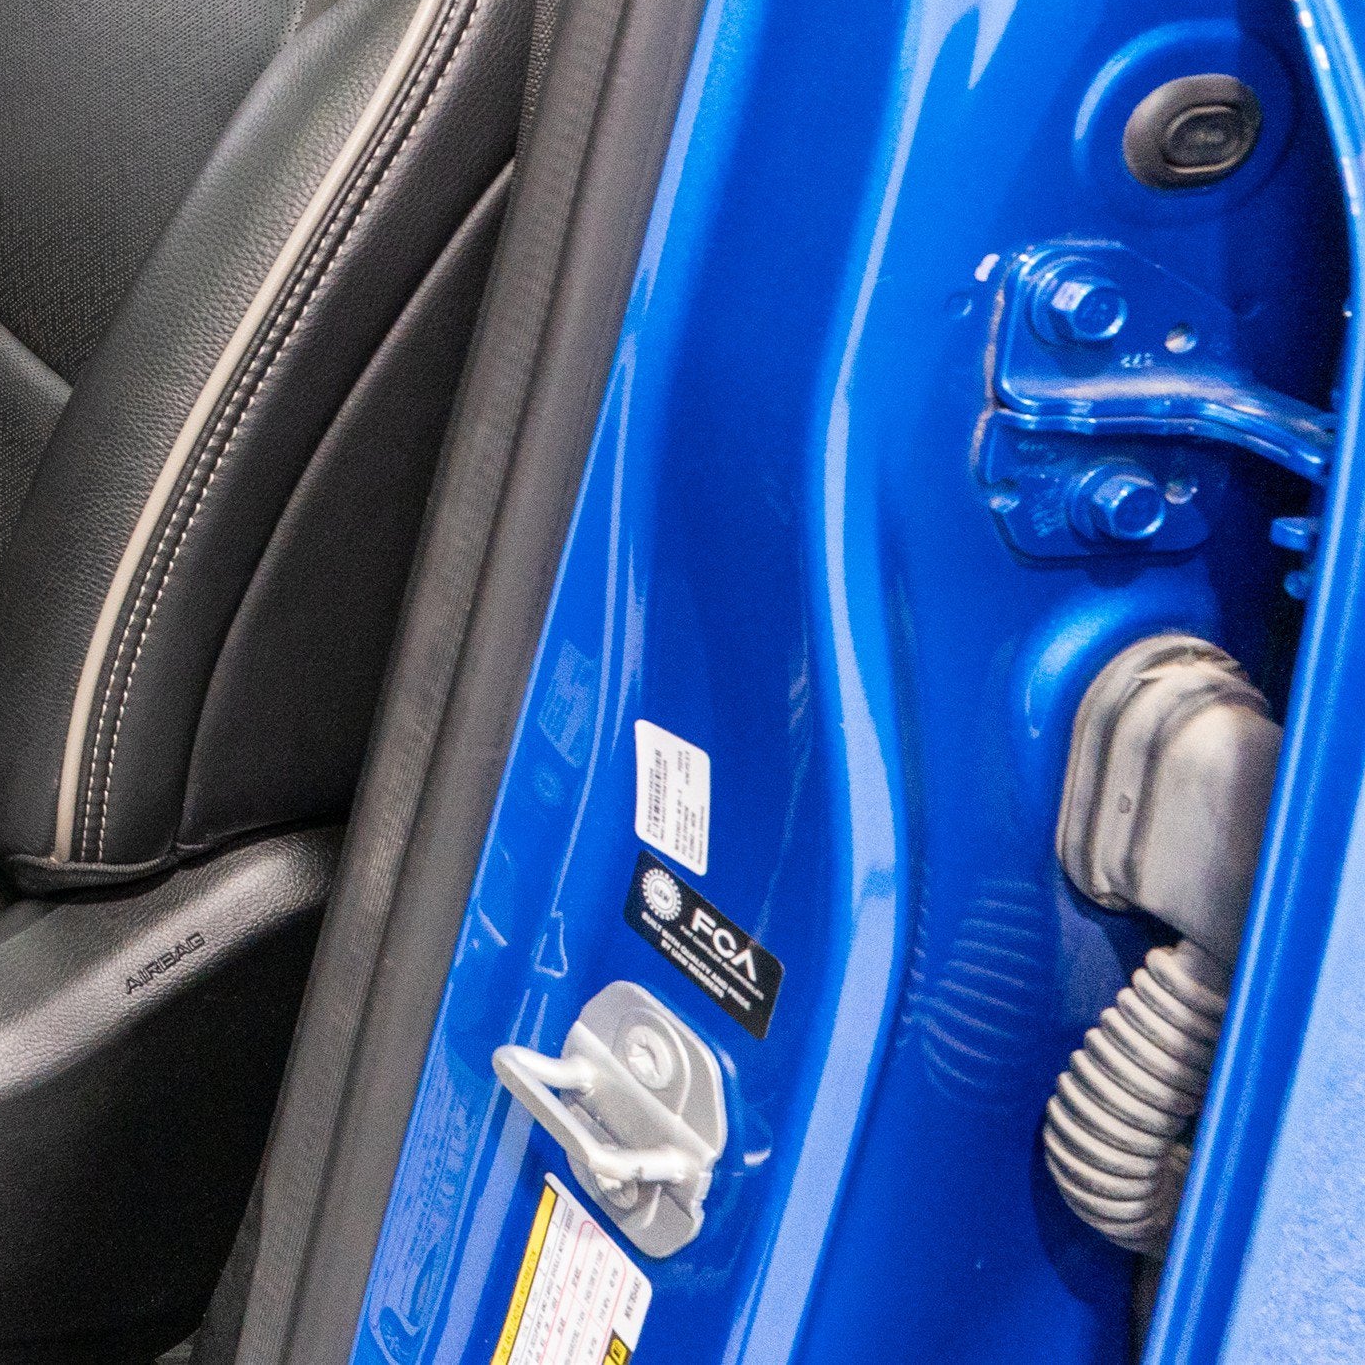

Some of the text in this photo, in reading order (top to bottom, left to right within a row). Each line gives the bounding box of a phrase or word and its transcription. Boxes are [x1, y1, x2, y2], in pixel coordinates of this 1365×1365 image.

[123, 931, 206, 995] AIRBAG
[679, 942, 712, 976] QUALITY
[690, 907, 758, 983] FCA
